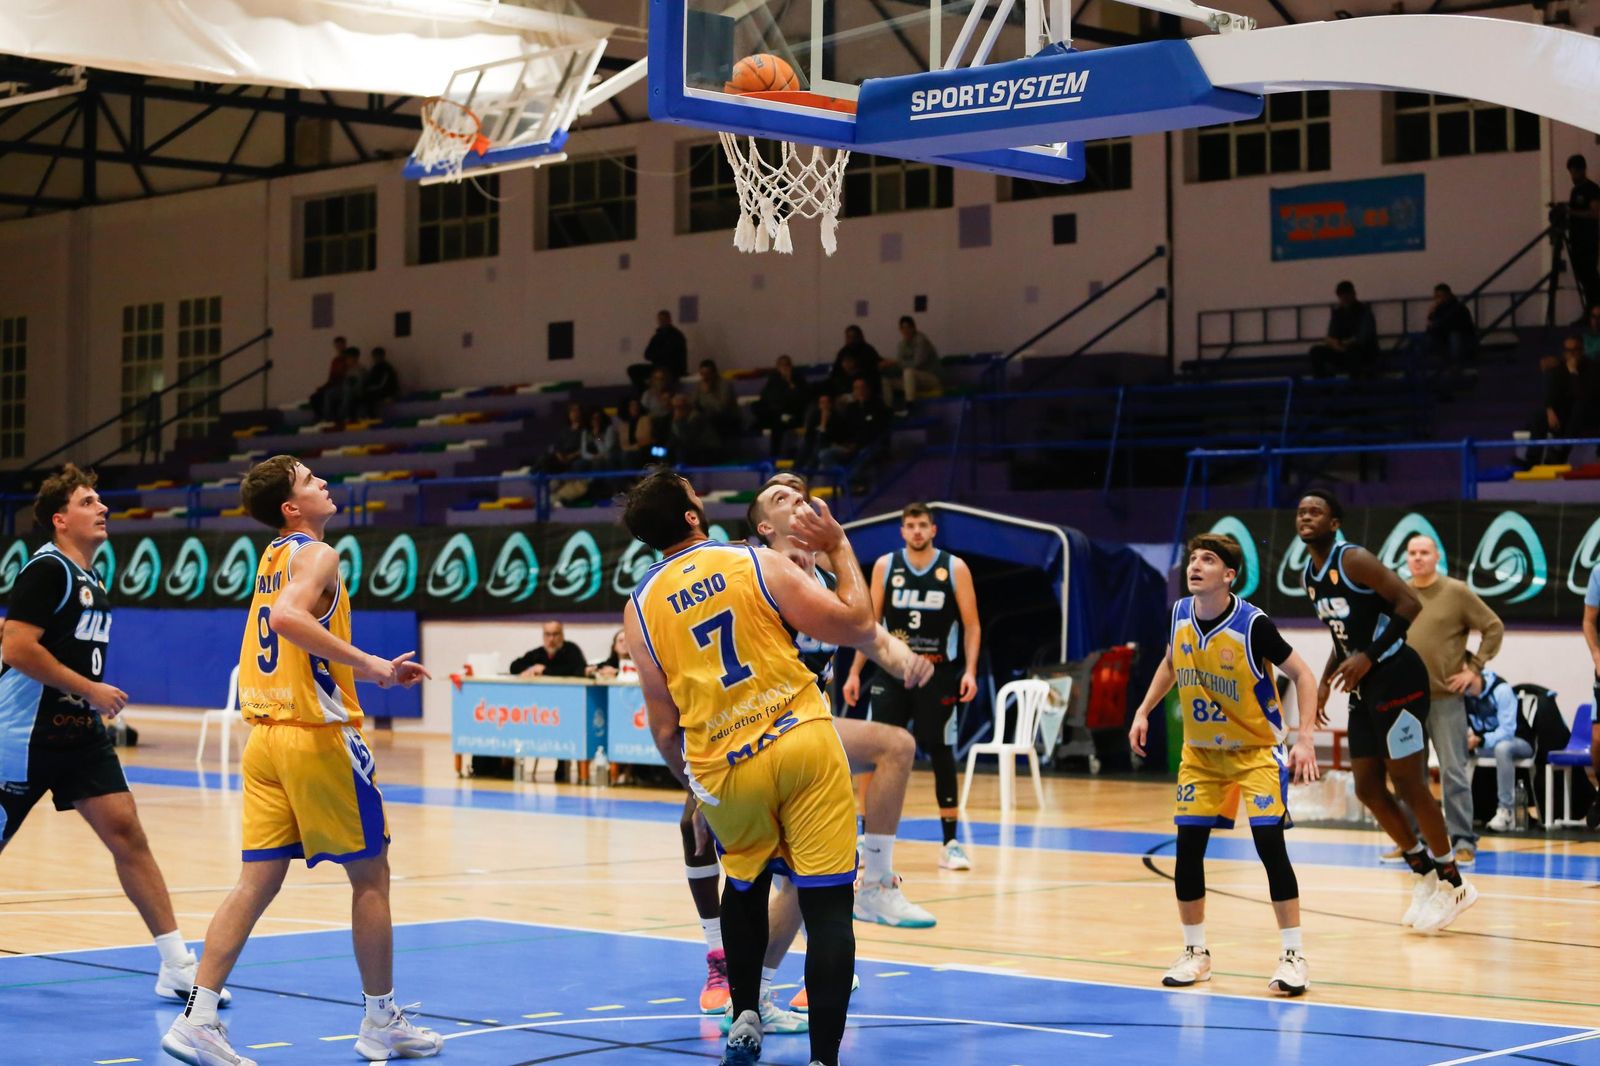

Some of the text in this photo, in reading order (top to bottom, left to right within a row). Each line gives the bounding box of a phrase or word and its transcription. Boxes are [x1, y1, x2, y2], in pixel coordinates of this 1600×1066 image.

[911, 70, 1090, 112] SPORT SYSTEM
[667, 572, 727, 615] TASIO
[892, 589, 945, 610] ULB
[908, 610, 922, 630] 3
[256, 605, 279, 675] 9
[690, 607, 755, 690] 7
[91, 647, 103, 676] 0
[473, 699, 560, 728] deportes
[710, 712, 763, 742] education
[765, 702, 780, 718] for
[1192, 698, 1228, 723] 82
[1176, 783, 1195, 802] 82
